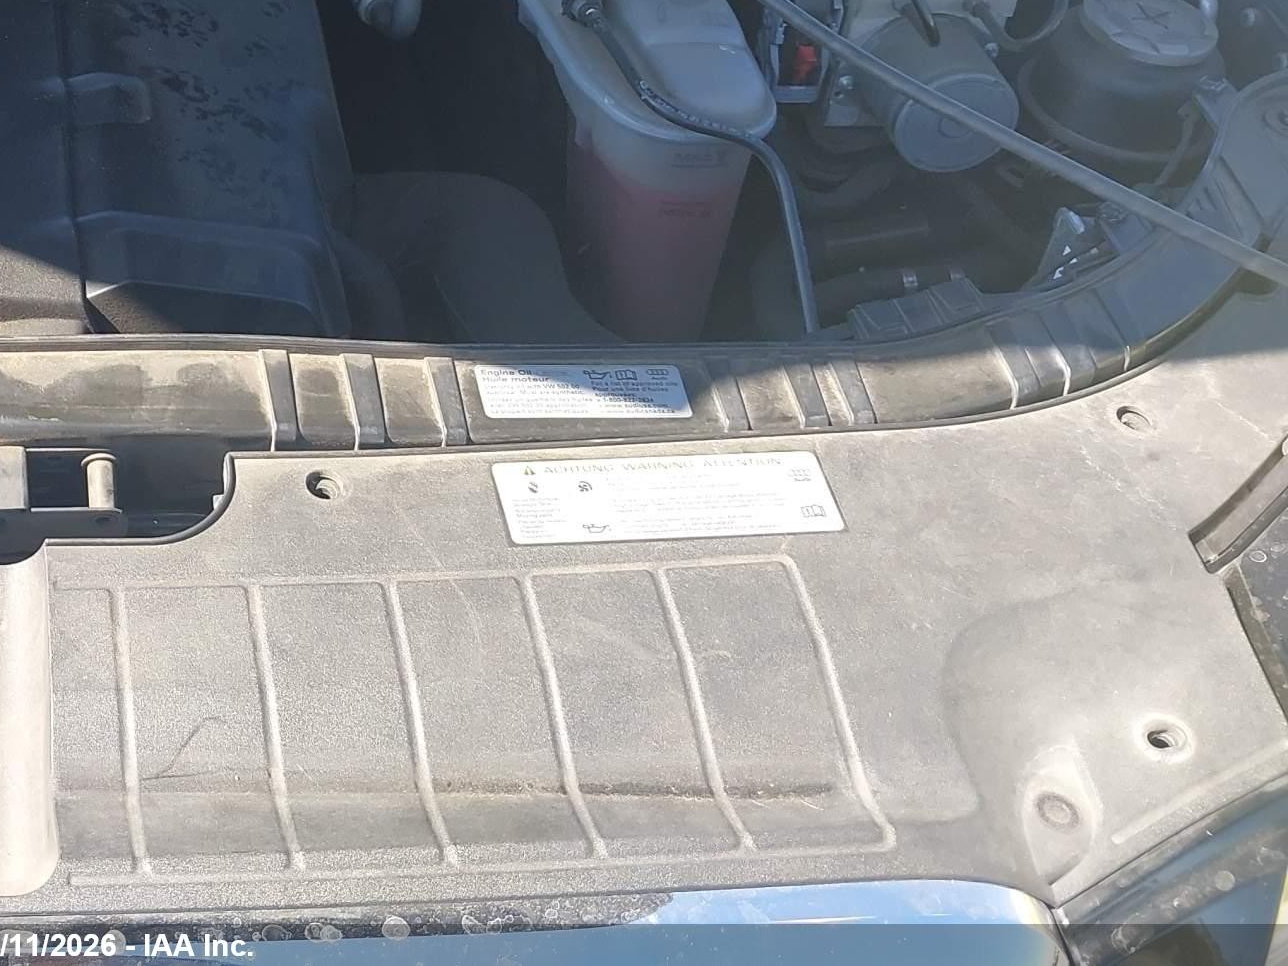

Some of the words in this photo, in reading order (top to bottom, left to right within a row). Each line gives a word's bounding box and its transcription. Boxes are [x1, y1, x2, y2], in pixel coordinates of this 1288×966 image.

[481, 369, 515, 378] Engine
[543, 464, 614, 474] ACHTUNG
[623, 460, 695, 471] WARNING
[703, 457, 784, 468] ATTENTION
